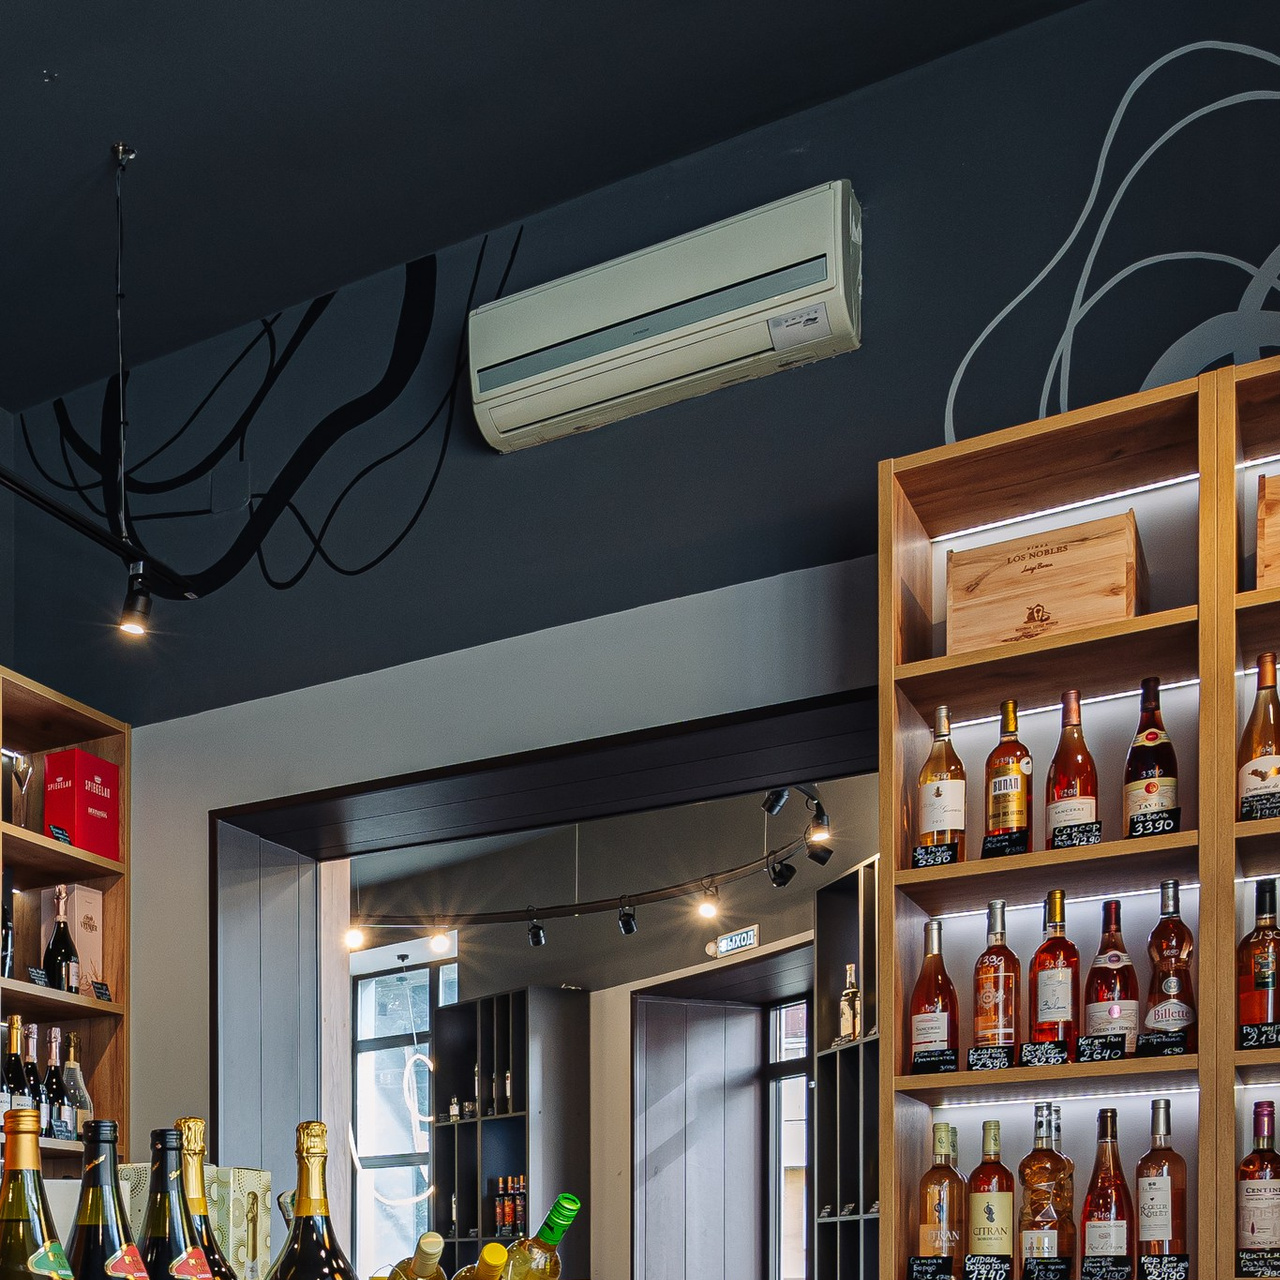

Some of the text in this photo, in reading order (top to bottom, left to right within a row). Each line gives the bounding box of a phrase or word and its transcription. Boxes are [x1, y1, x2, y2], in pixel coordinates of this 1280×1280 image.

[1007, 545, 1068, 564] LOS NOBLES
[993, 778, 1019, 792] BUNAN
[1138, 801, 1166, 810] TAVEL
[1132, 819, 1174, 836] 3390
[918, 855, 951, 866] 5590
[1153, 1008, 1191, 1020] Billette
[1080, 1049, 1121, 1062] 2640
[972, 1227, 1008, 1236] CITRAN
